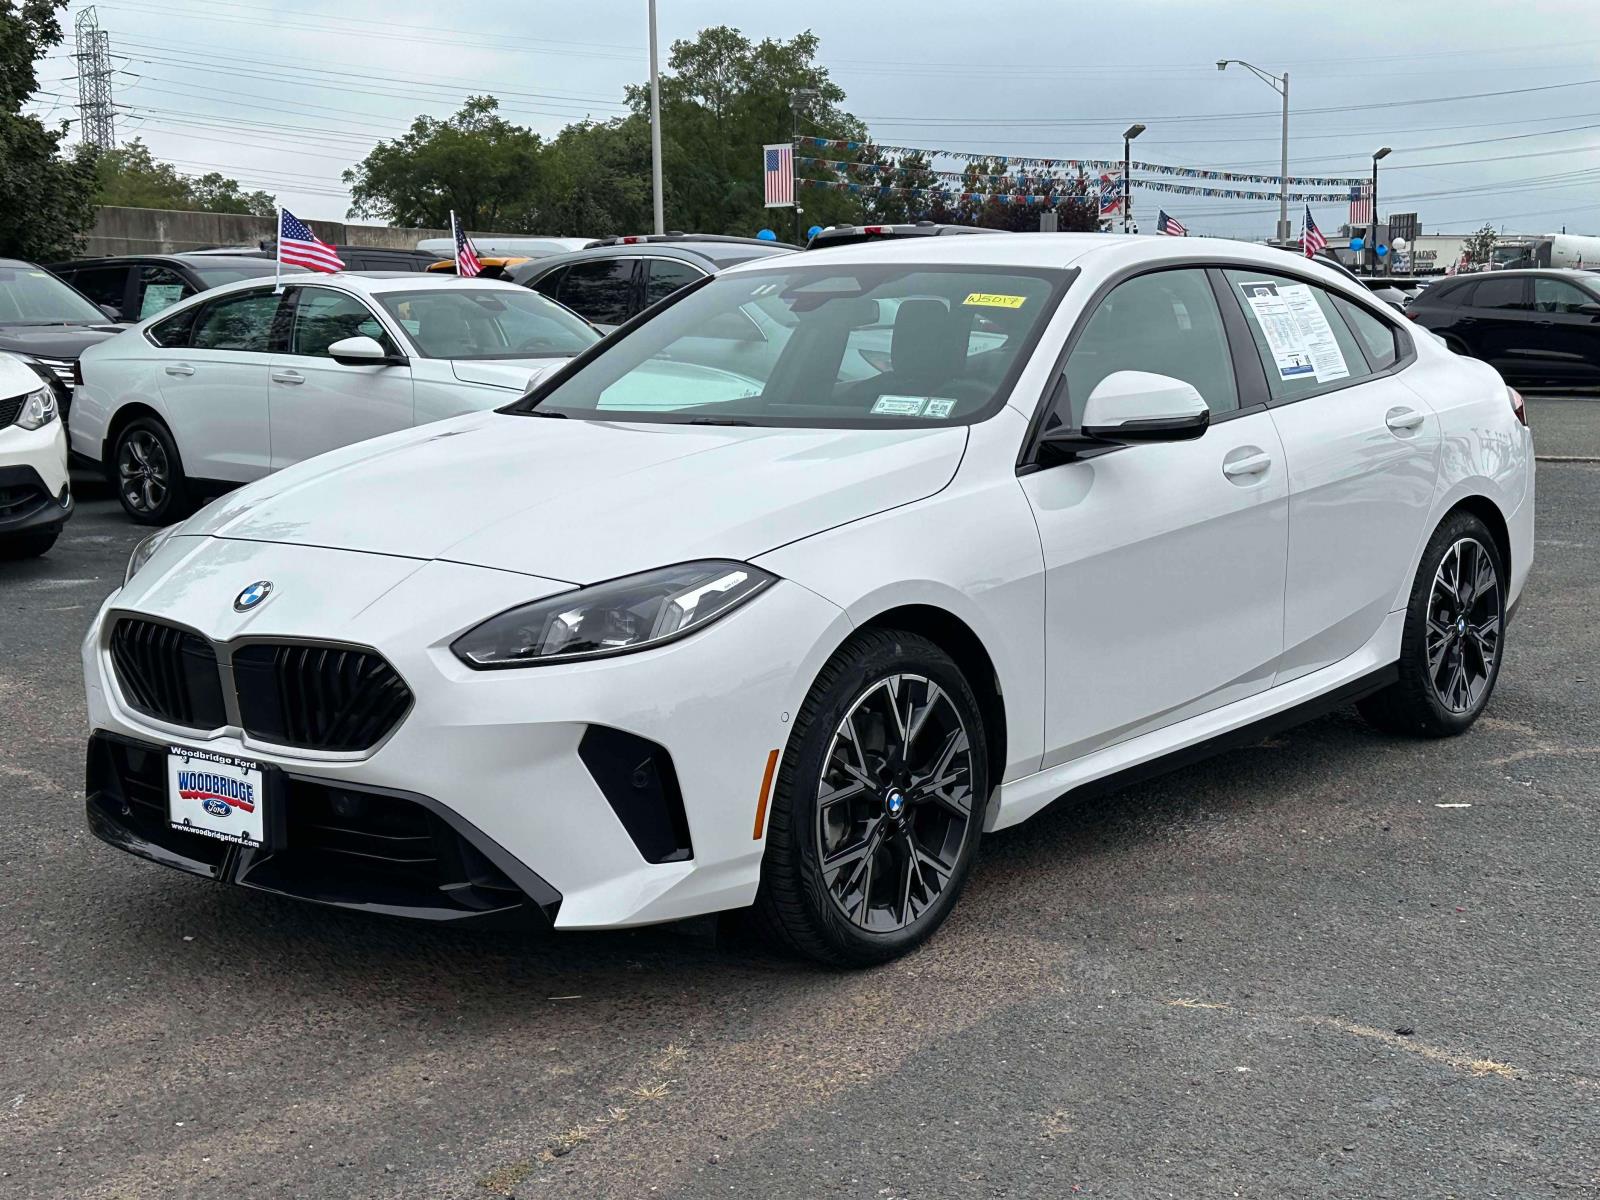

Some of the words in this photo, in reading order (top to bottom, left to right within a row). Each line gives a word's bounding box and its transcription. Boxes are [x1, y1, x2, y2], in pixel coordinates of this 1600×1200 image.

[234, 758, 257, 769] Ford
[178, 771, 254, 804] WOODBRIDGE
[207, 800, 227, 815] Ford
[171, 822, 260, 848] www.woodbridgeford.com
